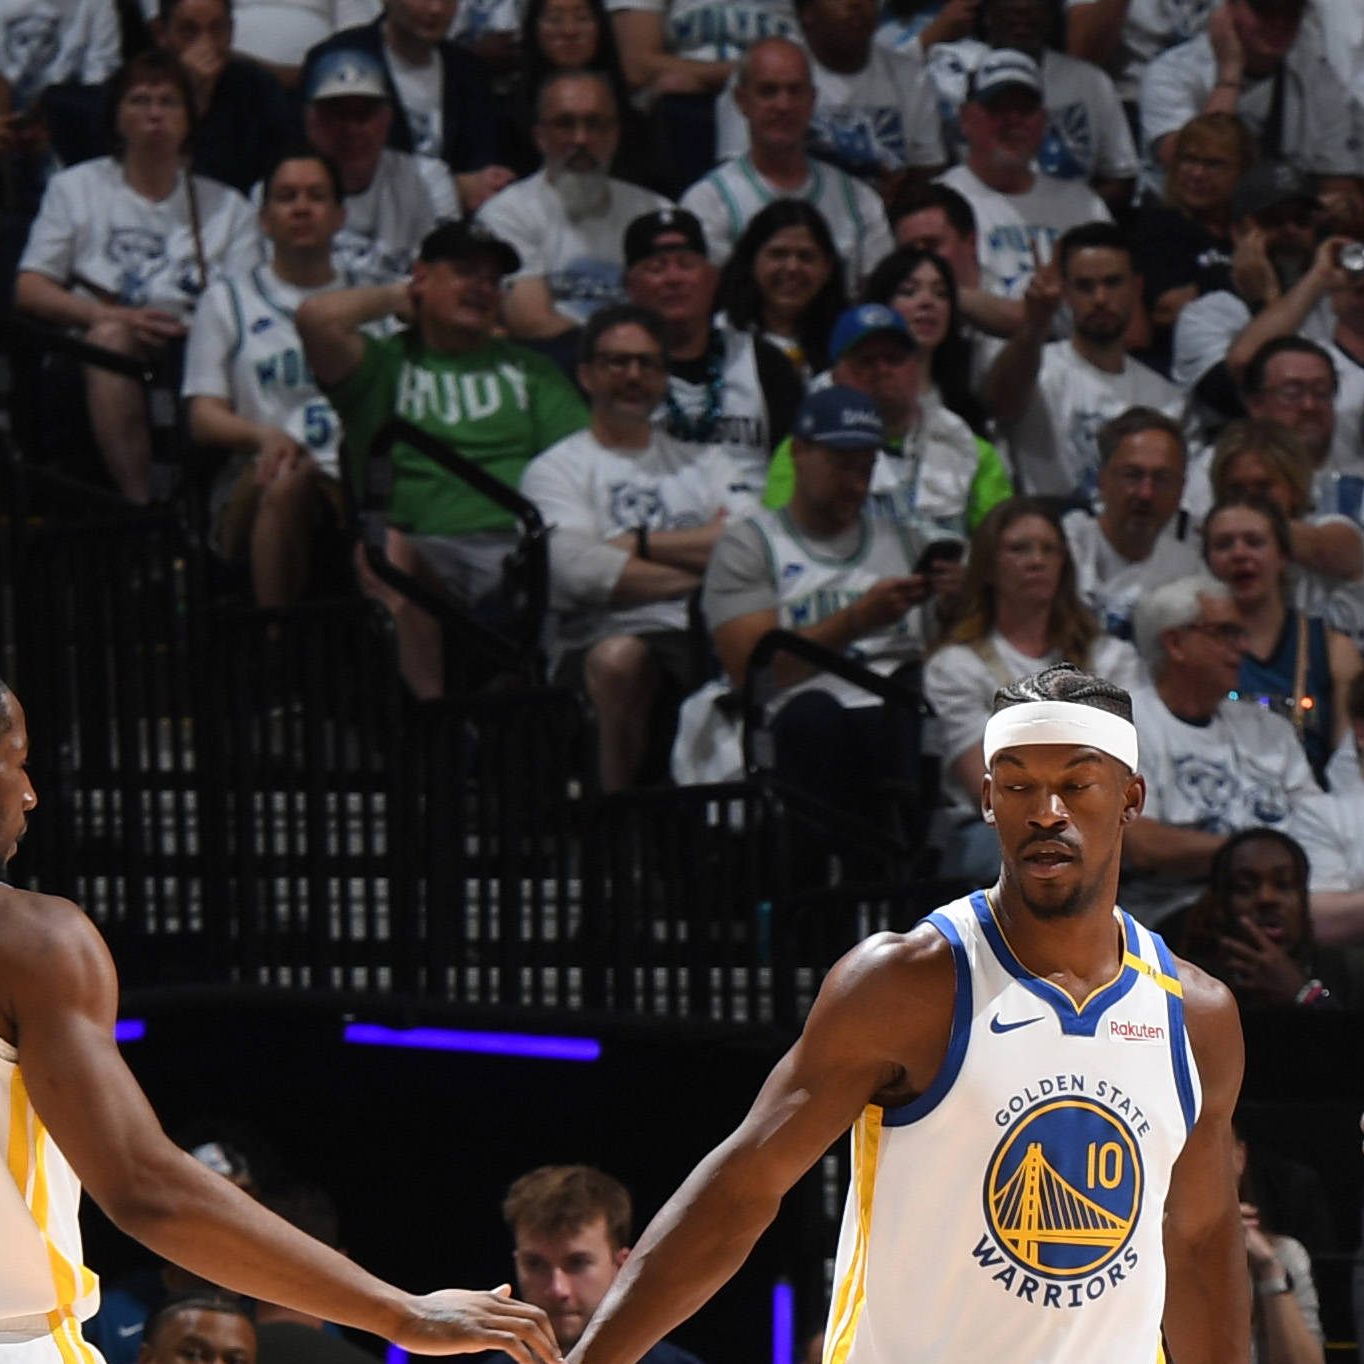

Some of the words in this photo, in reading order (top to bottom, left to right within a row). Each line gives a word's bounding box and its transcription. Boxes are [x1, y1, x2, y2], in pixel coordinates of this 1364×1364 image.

[395, 360, 530, 425] RUDY
[1110, 1021, 1165, 1041] Rakuten
[995, 1074, 1085, 1127] GOLDEN
[1095, 1080, 1151, 1138] STATE
[1086, 1141, 1124, 1190] 10
[971, 1233, 1139, 1309] WARRIORS
